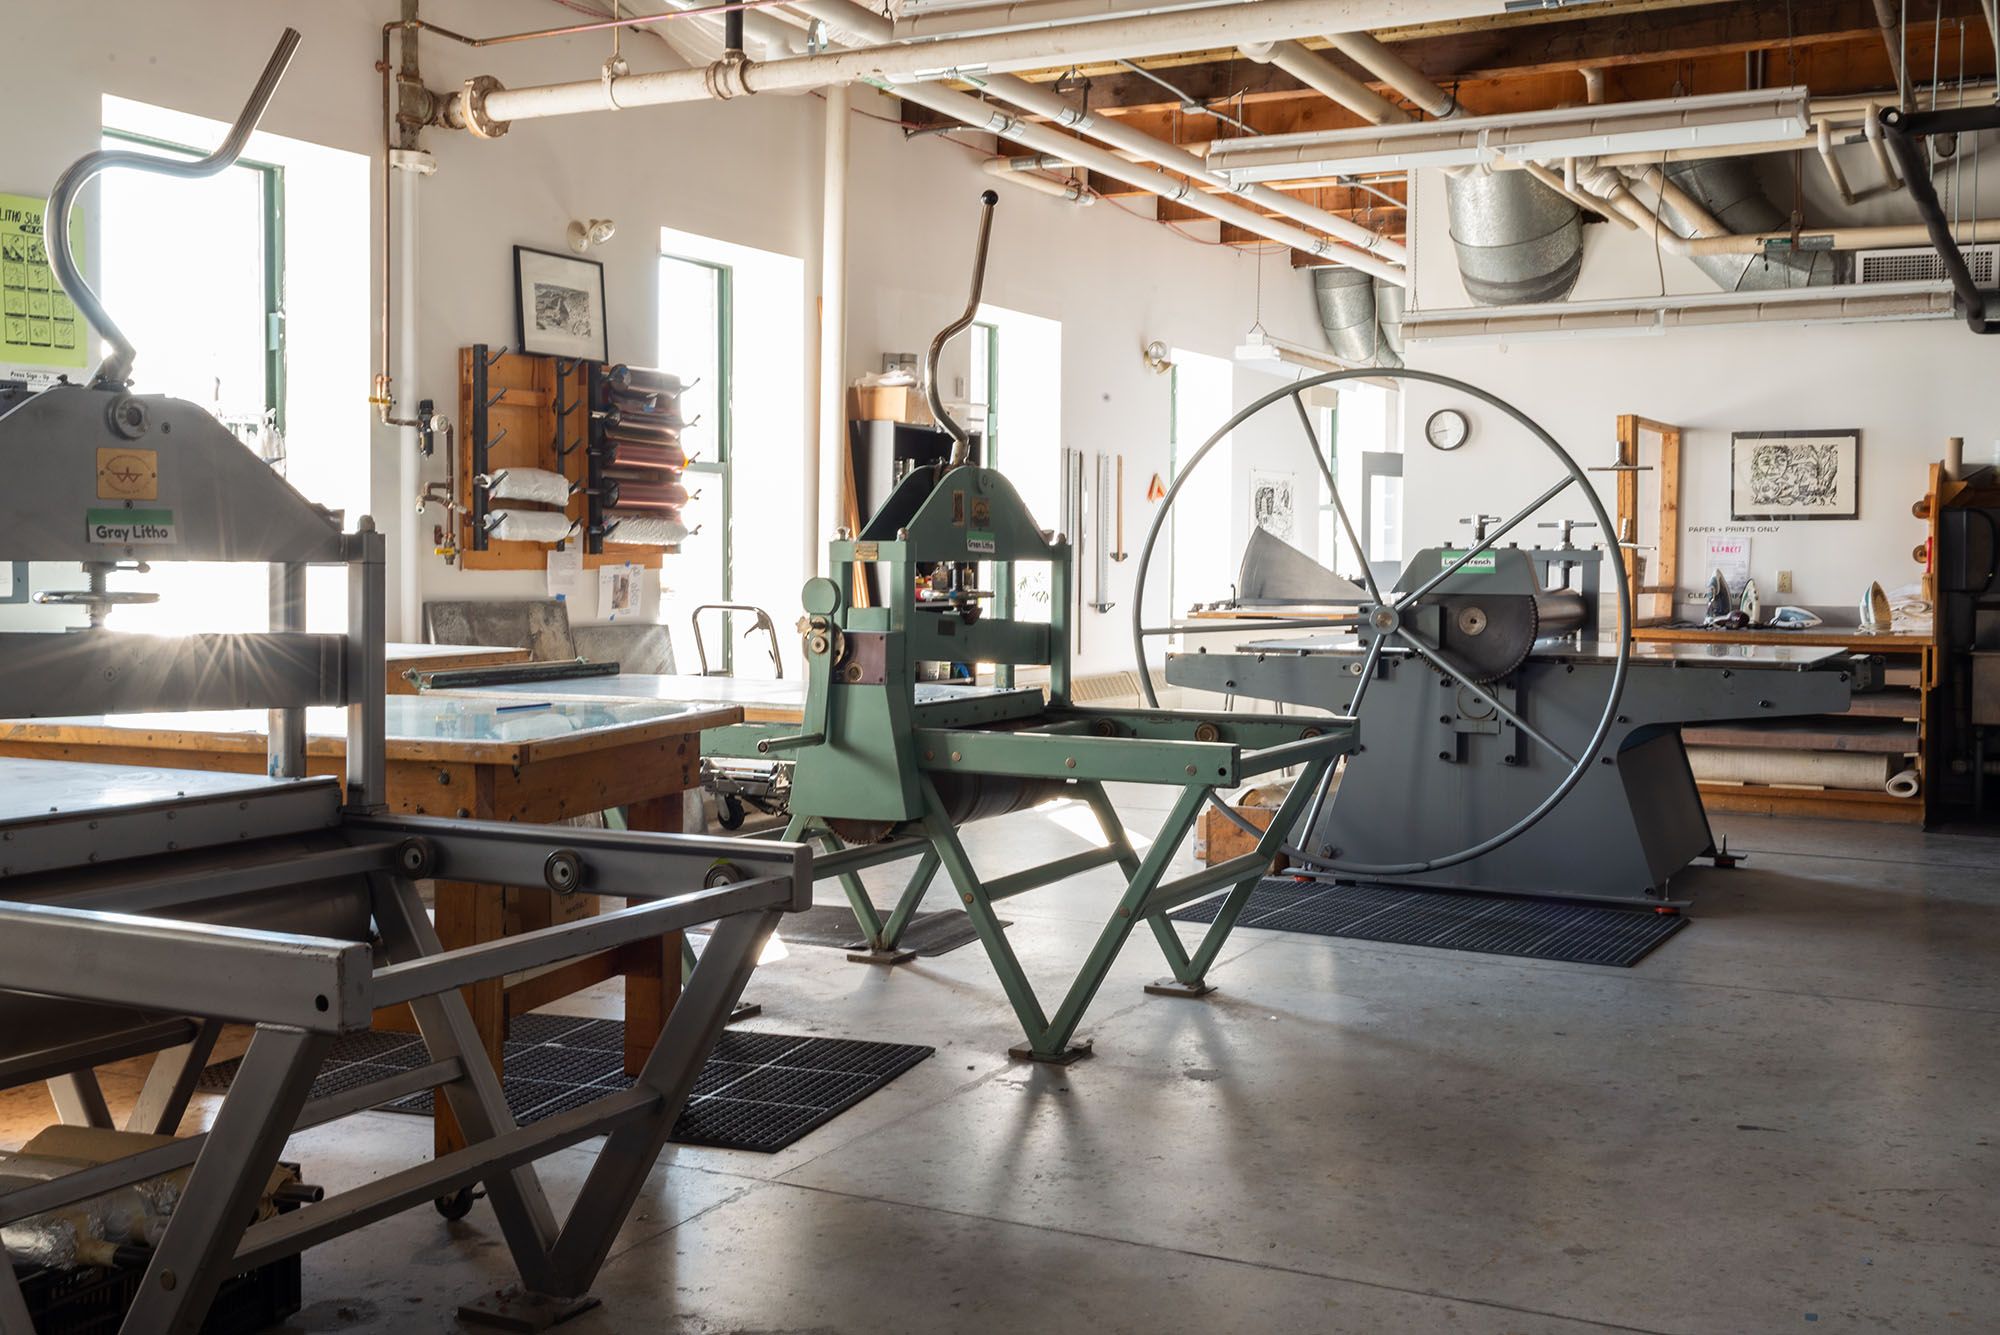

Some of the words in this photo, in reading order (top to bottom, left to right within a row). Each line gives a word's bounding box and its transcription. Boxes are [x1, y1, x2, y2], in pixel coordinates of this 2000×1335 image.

[0, 208, 21, 222] LITHO
[96, 525, 129, 542] Gray
[133, 525, 168, 538] Litho
